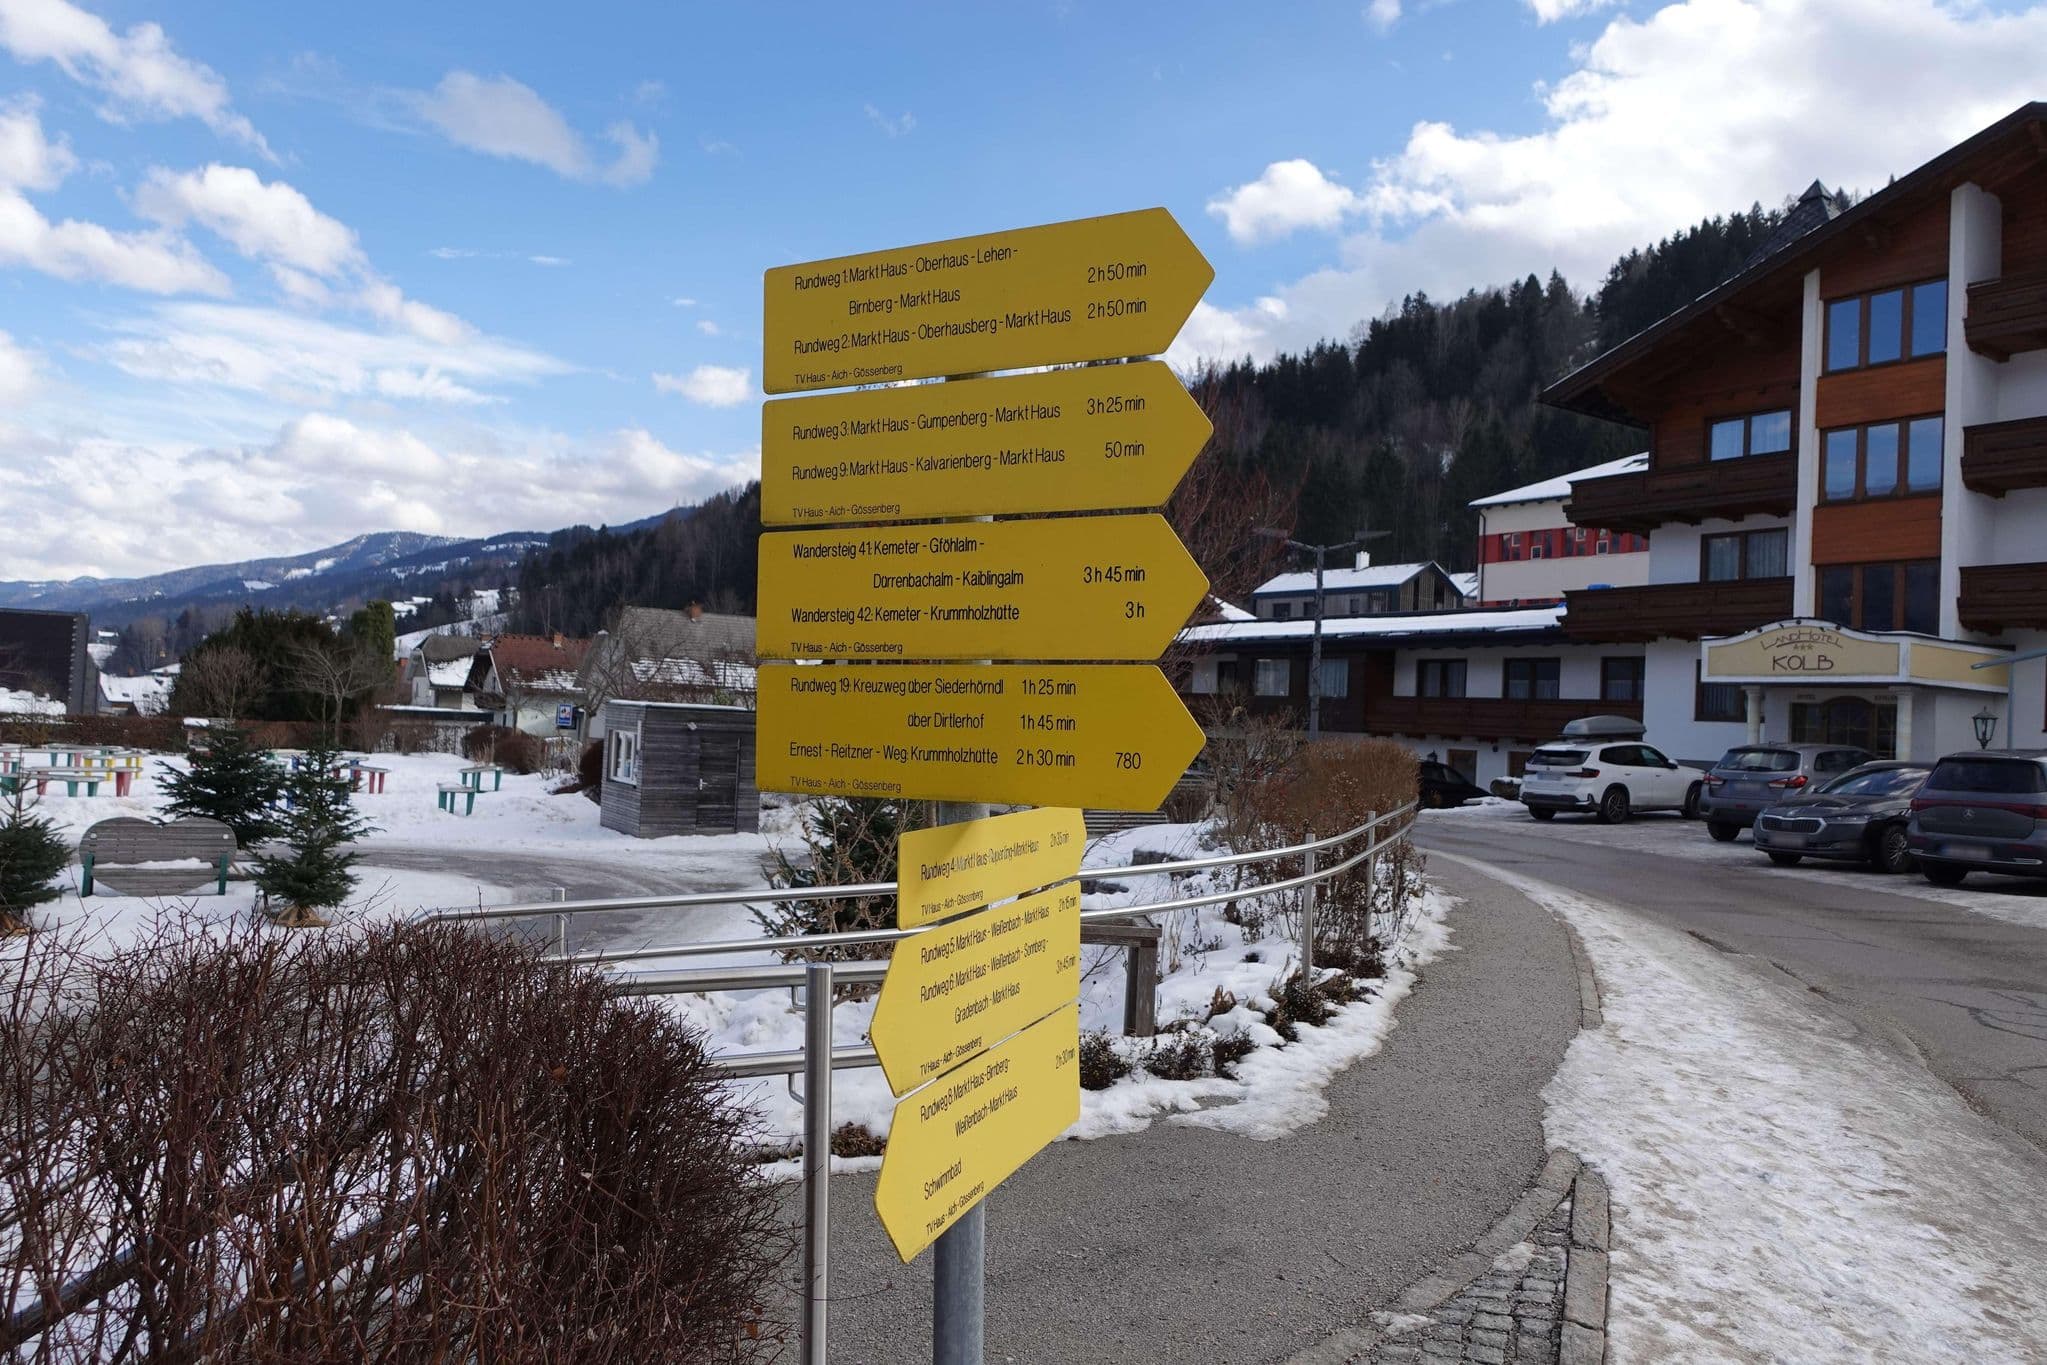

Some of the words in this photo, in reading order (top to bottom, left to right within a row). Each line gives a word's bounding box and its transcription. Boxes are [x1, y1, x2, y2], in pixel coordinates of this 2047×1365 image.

[794, 273, 840, 291] Rundweg
[848, 265, 880, 283] Markt
[880, 263, 907, 278] Haus
[915, 254, 968, 273] Oberhaus
[976, 247, 1011, 264] Lehen
[849, 298, 892, 316] Birnberg
[900, 290, 931, 308] Markt
[932, 289, 960, 304] Haus
[794, 338, 839, 355] Rundweg
[850, 330, 882, 347] Markt
[882, 329, 909, 344] Haus
[917, 318, 996, 340] Oberhausberg
[1005, 310, 1038, 329] Markt
[1041, 309, 1071, 325] Haus
[793, 425, 838, 441] Rundweg
[850, 418, 880, 435] Markt
[882, 417, 909, 433] Haus
[917, 411, 986, 430] Gumpenberg
[995, 405, 1029, 423] Markt
[1030, 404, 1060, 420] Haus
[792, 465, 837, 482] Rundweg
[849, 460, 879, 476] Markt
[881, 459, 908, 474] Haus
[916, 454, 991, 471] Kalvarienberg
[999, 448, 1033, 466] Markt
[1035, 447, 1065, 463] Haus
[803, 507, 823, 518] Haus
[829, 505, 845, 517] Aich
[851, 504, 900, 515] Gössenberg
[793, 542, 856, 559] Wandersteig
[874, 540, 920, 555] Kemeter
[929, 537, 977, 553] Gföhlalm
[962, 570, 1023, 588] Kaiblingalm
[791, 608, 854, 625] Wandersteig
[875, 606, 921, 622] Kemeter
[1772, 654, 1834, 671] KOLB
[791, 677, 836, 696] Rundweg
[853, 678, 905, 697] Kreuzweg
[934, 678, 1003, 695] Siederhörndl
[933, 712, 984, 729] Dirtlerhof
[790, 741, 821, 758] Ernest
[830, 743, 873, 759] Reitzner
[1115, 752, 1141, 770] 780
